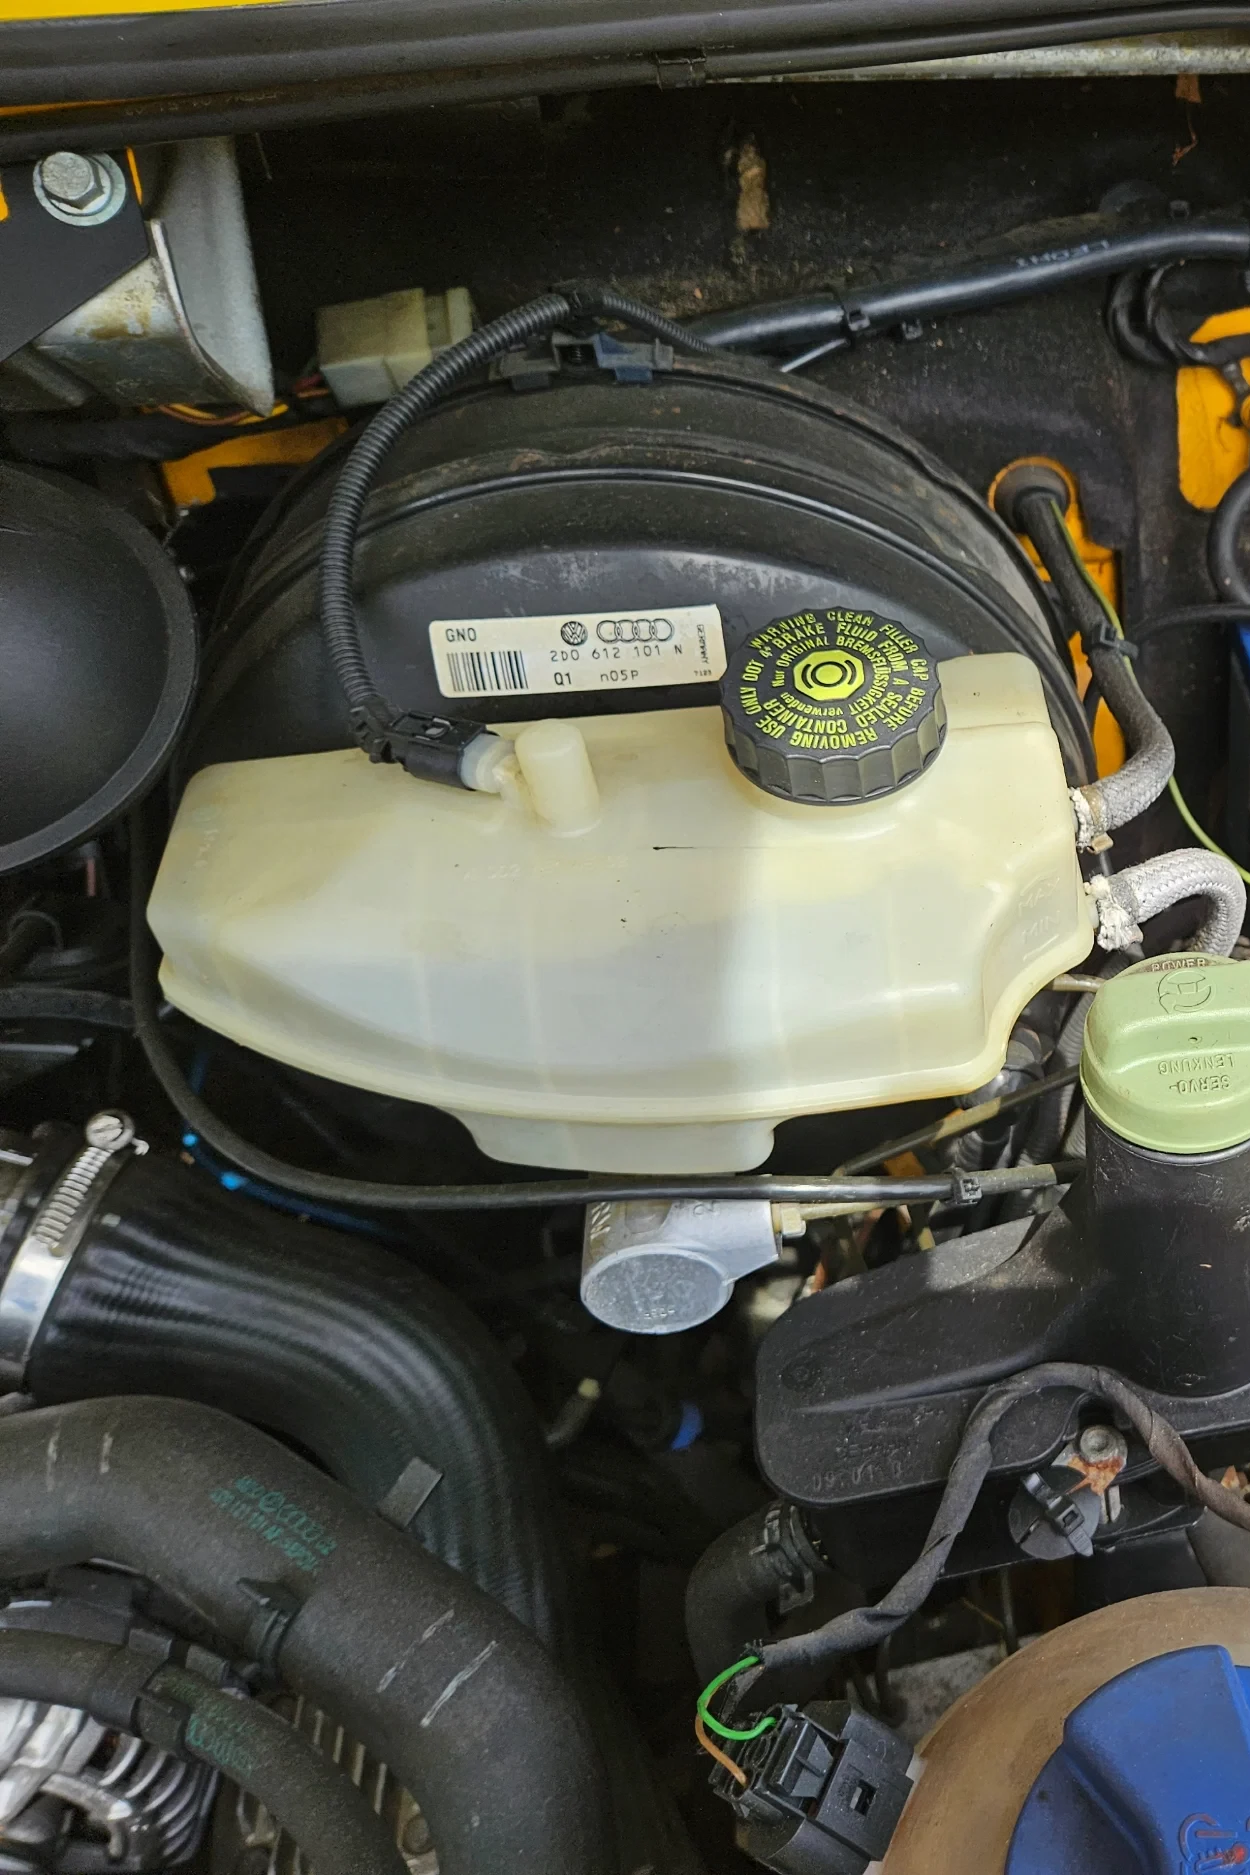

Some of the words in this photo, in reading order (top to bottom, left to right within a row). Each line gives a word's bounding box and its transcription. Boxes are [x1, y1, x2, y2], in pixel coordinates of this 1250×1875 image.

[826, 611, 874, 626] CLEAN
[749, 613, 816, 649] WARNING
[771, 623, 826, 650] BRAKE
[836, 622, 878, 642] FLUID
[879, 623, 919, 654] FILLER
[592, 648, 620, 660] 612
[634, 646, 661, 659] 101
[674, 644, 683, 655] N
[776, 636, 830, 667] ORIGINAL
[877, 640, 909, 672] FROM
[554, 672, 572, 686] Q1
[742, 659, 765, 682] DOT
[771, 670, 785, 687] Nur
[892, 677, 910, 686] A
[910, 659, 929, 681] CAP
[740, 687, 762, 715] ONLY
[780, 692, 844, 716] verwenden
[855, 692, 903, 728] SEALED
[882, 687, 926, 731] BEFORE
[755, 715, 786, 739] USE
[763, 698, 848, 734] CONTAINER
[789, 727, 878, 749] REMOVING
[1022, 910, 1060, 944] MIN
[1151, 958, 1207, 973] POWER
[1158, 1053, 1234, 1075] LENKUNG
